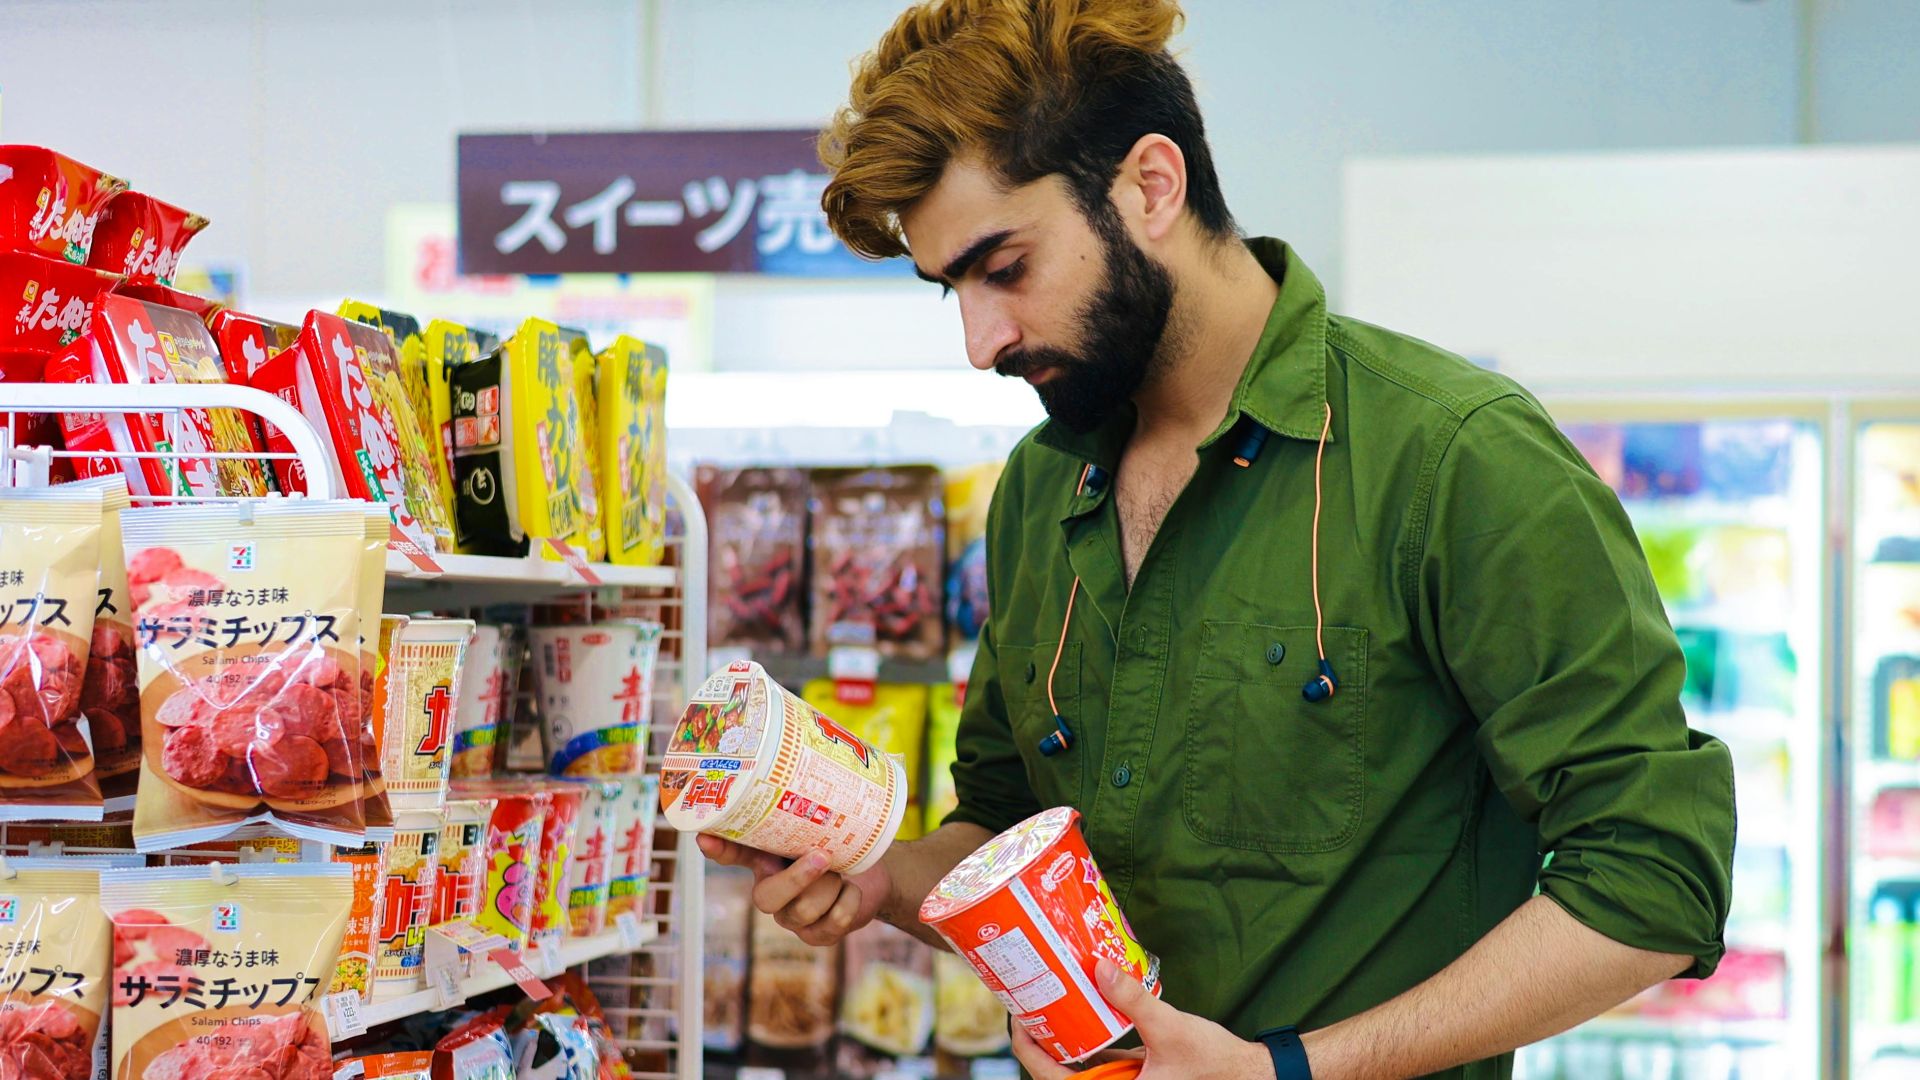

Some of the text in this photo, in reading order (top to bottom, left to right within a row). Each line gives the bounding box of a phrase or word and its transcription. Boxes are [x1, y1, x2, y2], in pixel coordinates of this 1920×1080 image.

[188, 586, 289, 607] 濃厚なうま味
[136, 609, 340, 651] サラミチップス
[202, 654, 271, 667] Salami Chips
[175, 948, 280, 968] 濃厚なうま味
[119, 971, 321, 1011] サラミチップス
[191, 1016, 262, 1028] Salami Chips
[214, 1036, 232, 1045] 192
